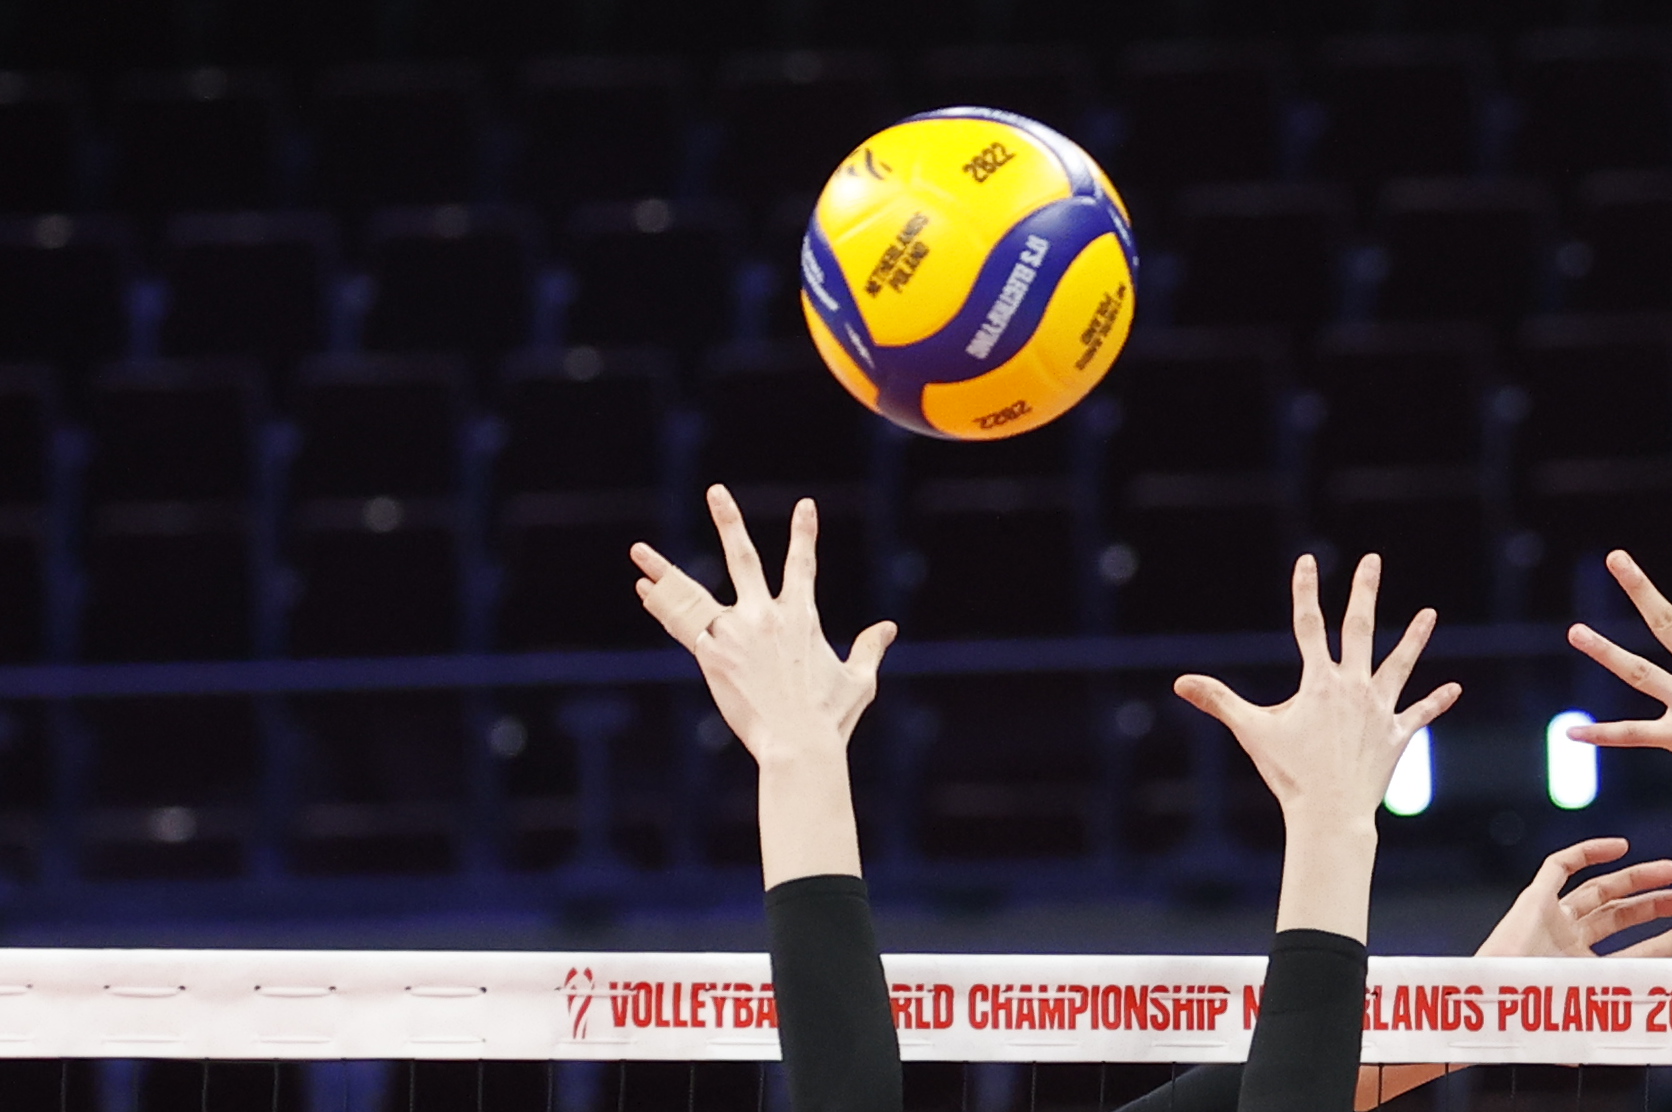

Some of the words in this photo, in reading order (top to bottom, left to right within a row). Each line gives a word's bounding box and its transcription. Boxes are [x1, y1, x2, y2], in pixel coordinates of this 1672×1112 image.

[610, 981, 780, 1029] VOLLEYBA
[889, 983, 955, 1030] RLD
[969, 984, 1228, 1032] CHAMPIONSHIP
[1499, 985, 1632, 1032] POLAND
